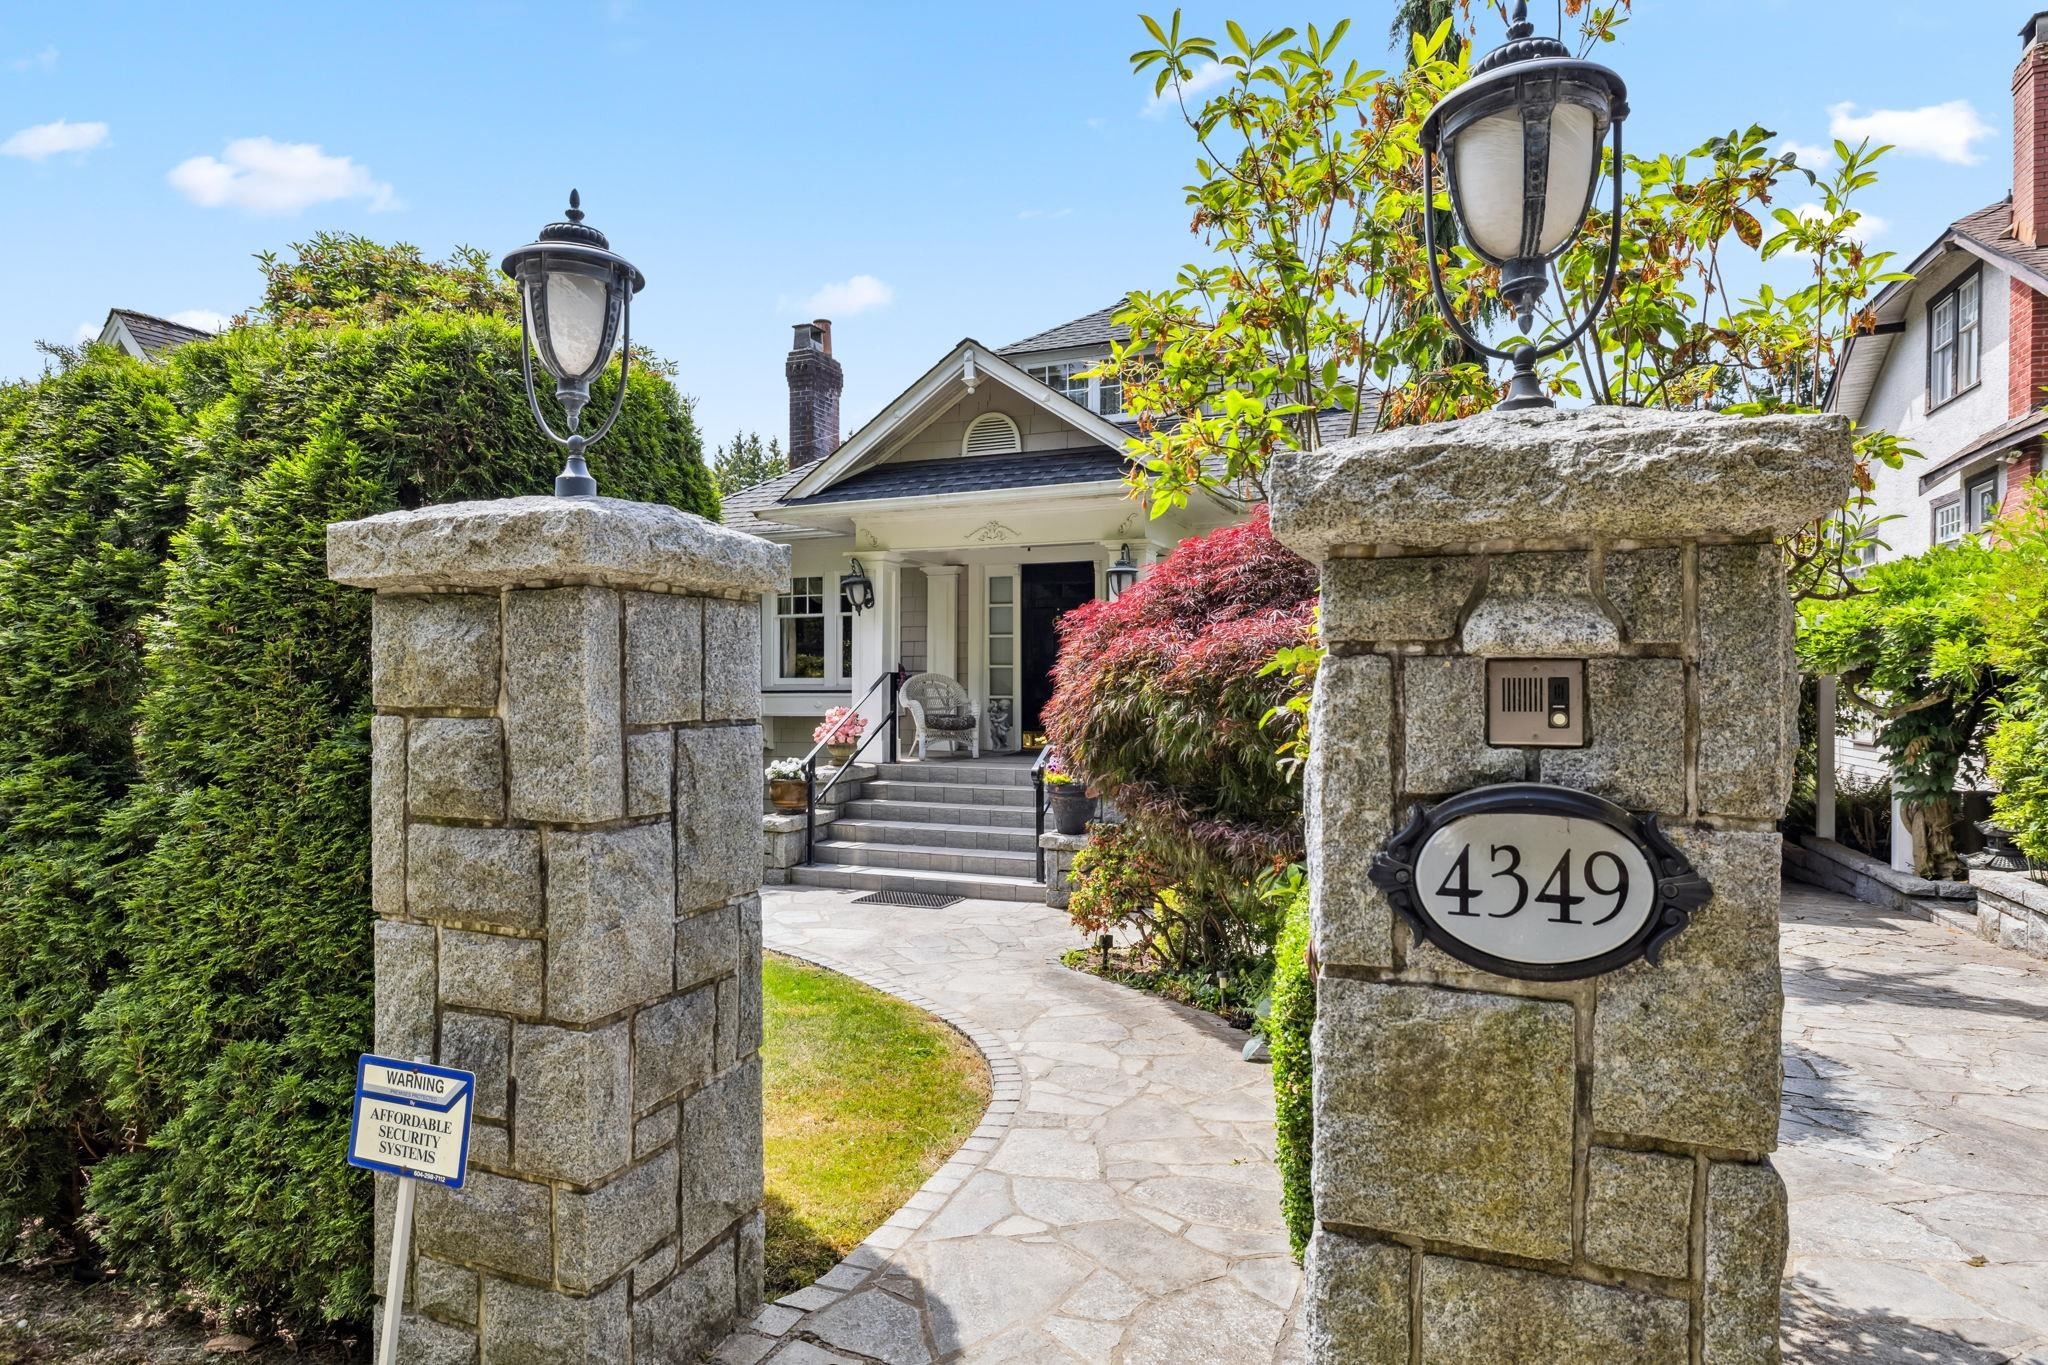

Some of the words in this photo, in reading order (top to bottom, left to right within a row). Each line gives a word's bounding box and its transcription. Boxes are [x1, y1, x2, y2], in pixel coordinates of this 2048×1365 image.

[1436, 842, 1630, 926] 4349
[386, 1070, 445, 1094] WARNING
[370, 1108, 452, 1135] AFFORDABLE
[378, 1125, 441, 1149] SECURITY
[378, 1141, 436, 1164] SYSTEMS
